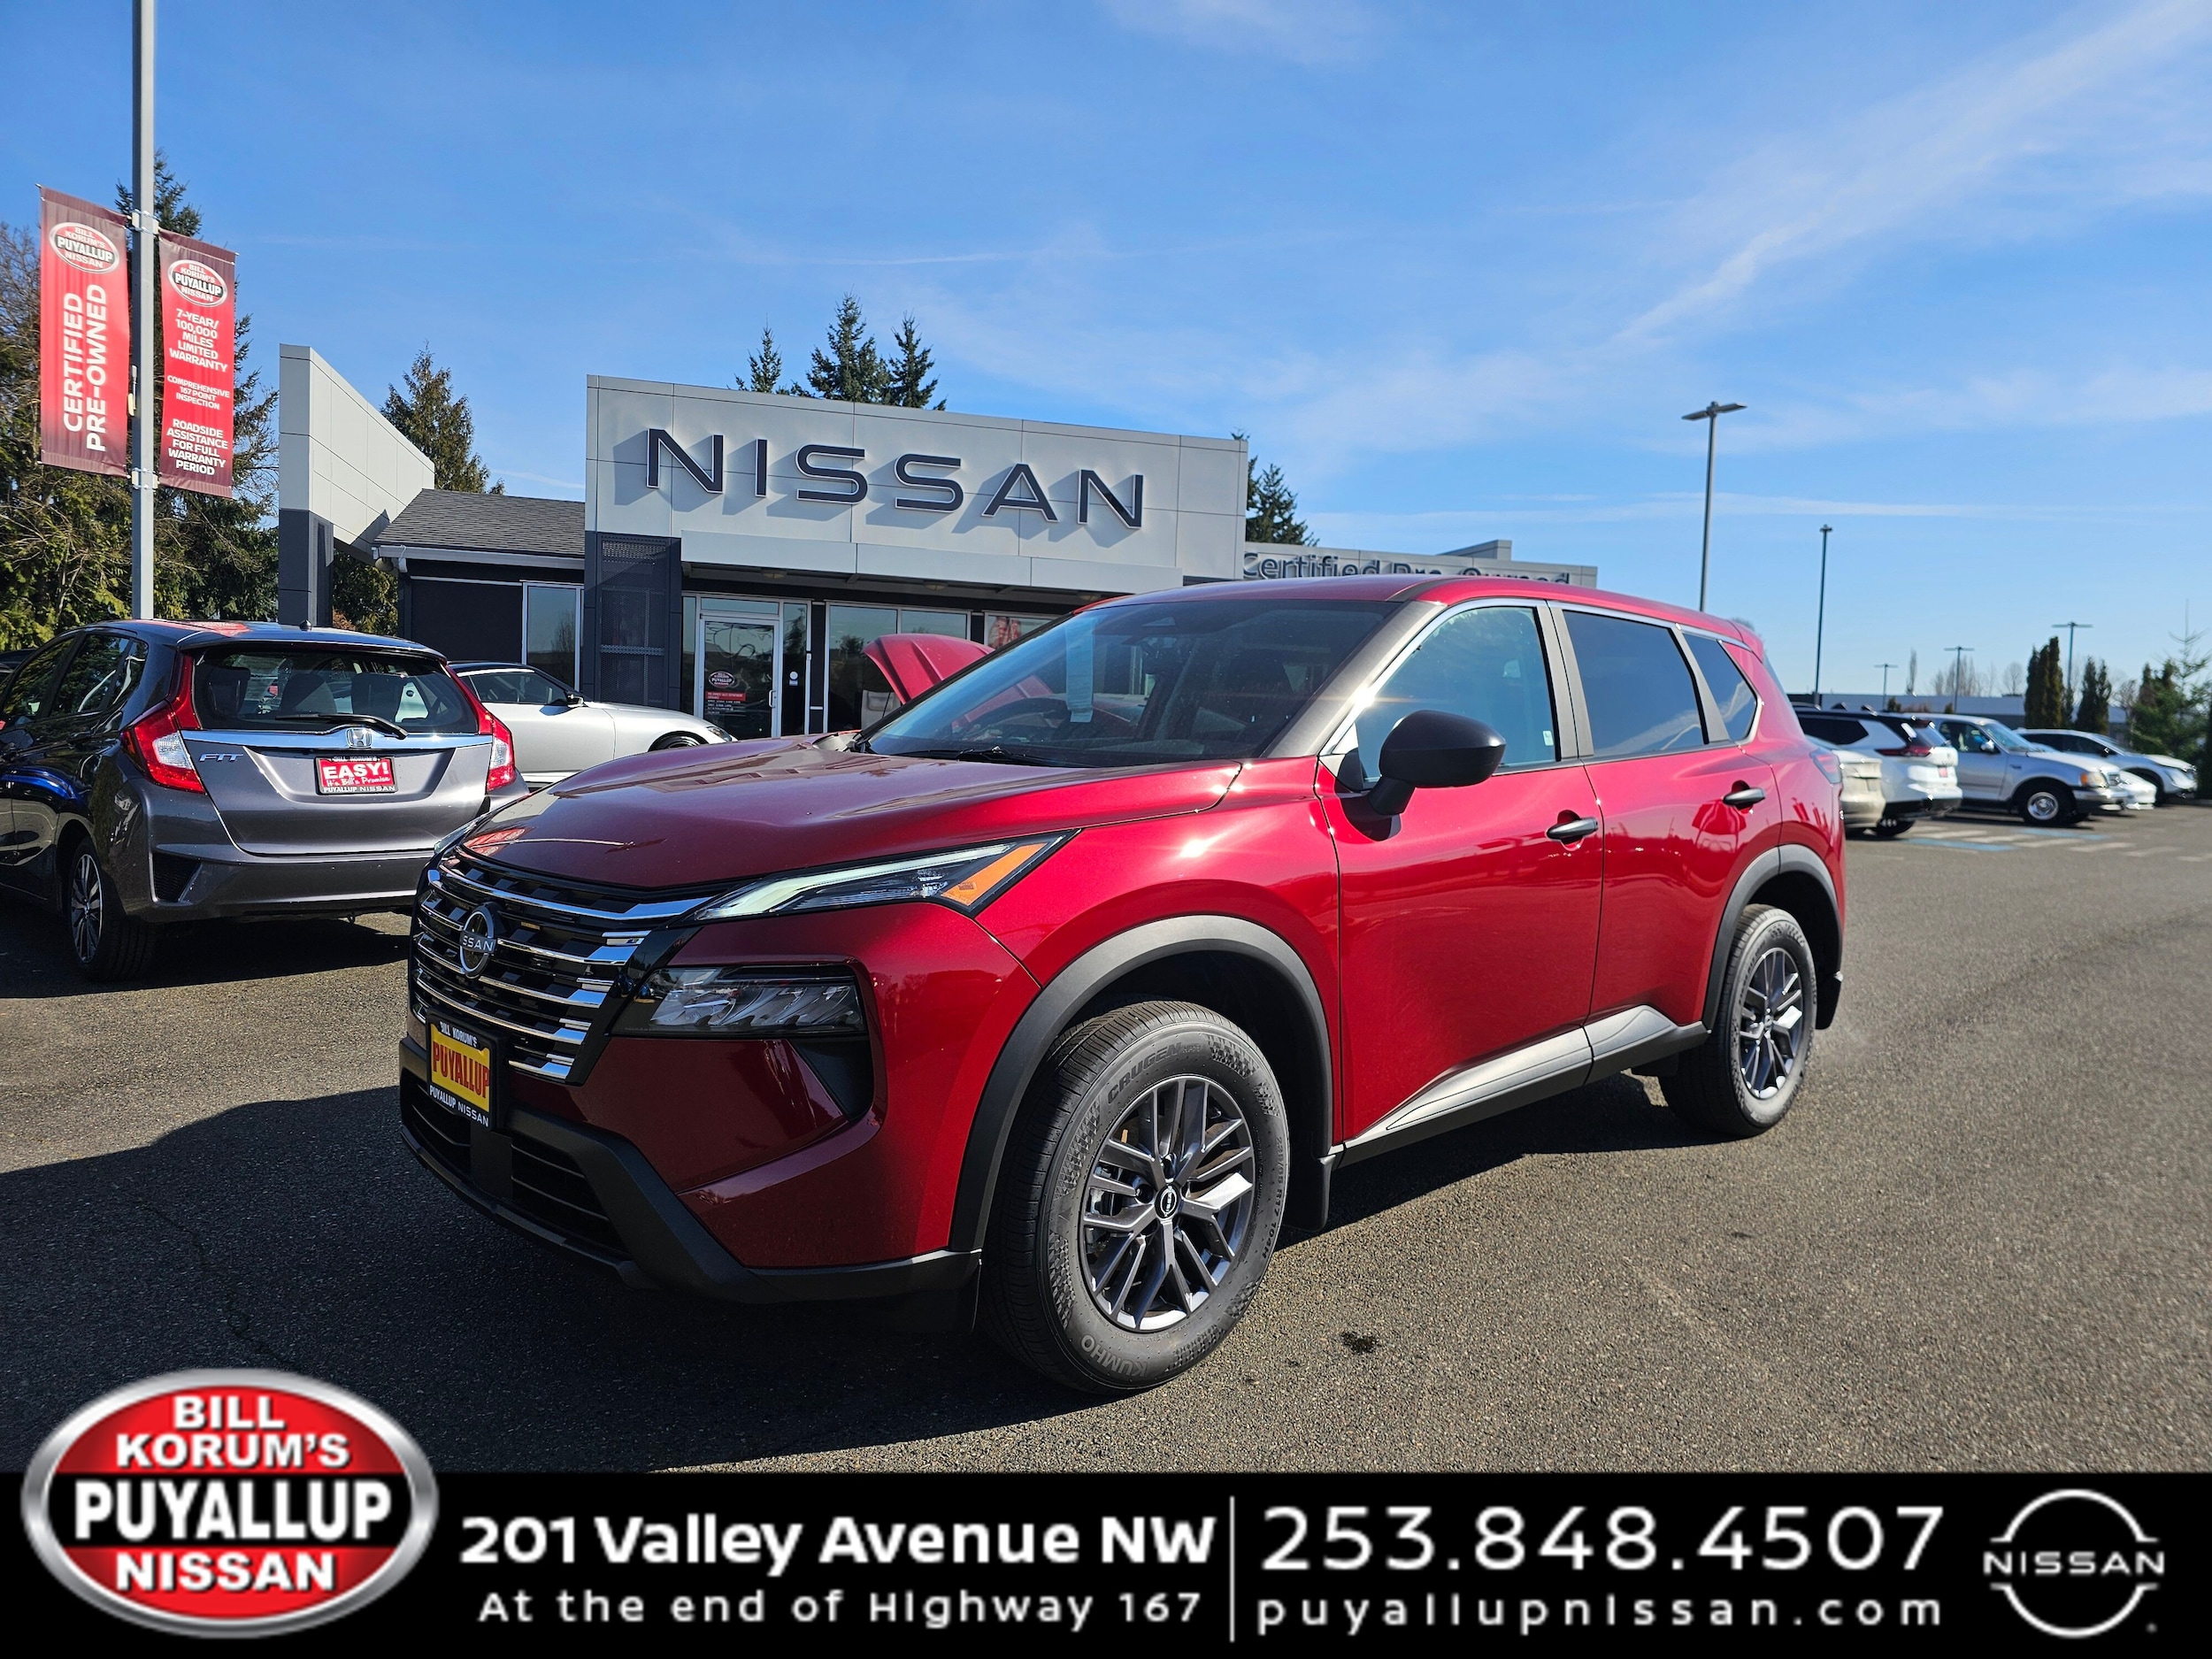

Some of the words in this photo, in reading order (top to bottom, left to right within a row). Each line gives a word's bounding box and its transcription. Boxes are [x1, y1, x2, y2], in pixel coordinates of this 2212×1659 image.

[65, 230, 105, 248] KORUM'S
[74, 227, 94, 237] BILL
[57, 235, 112, 263] PUYALLUP
[65, 251, 104, 268] NISSAN
[188, 264, 206, 273] BILL
[175, 273, 221, 296] PUYALLUP
[180, 267, 215, 283] KORUM'S
[180, 287, 213, 302] NISSAN
[175, 319, 218, 339] 100,000
[176, 308, 219, 330] 7-YEAR/
[178, 340, 219, 359] LIMITED
[182, 331, 214, 349] MILES
[63, 292, 83, 432] CERTIFIED
[86, 284, 106, 452] PRE-OWNED
[169, 348, 227, 373] WARRANTY
[167, 374, 230, 398] COMPREHENSIVE
[180, 386, 192, 396] 167
[192, 388, 217, 402] POINT
[176, 392, 219, 410] INSPECTION
[166, 428, 228, 449] ASSISTANCE
[173, 419, 224, 439] ROADSIDE
[168, 447, 227, 468] WARRANTY
[173, 438, 193, 451] FOR
[194, 443, 220, 457] FULL
[176, 459, 215, 476] PERIOD
[646, 427, 1144, 528] NISSAN
[199, 753, 244, 762] FIT
[322, 761, 389, 780] EASY!
[361, 775, 391, 785] Promise
[433, 1041, 490, 1099] PUYALLUP
[1107, 1041, 1182, 1105] CRUGEN
[429, 1085, 457, 1109] PUYALLUP
[457, 1101, 489, 1127] NISSAN
[1080, 1333, 1148, 1377] KUMHO
